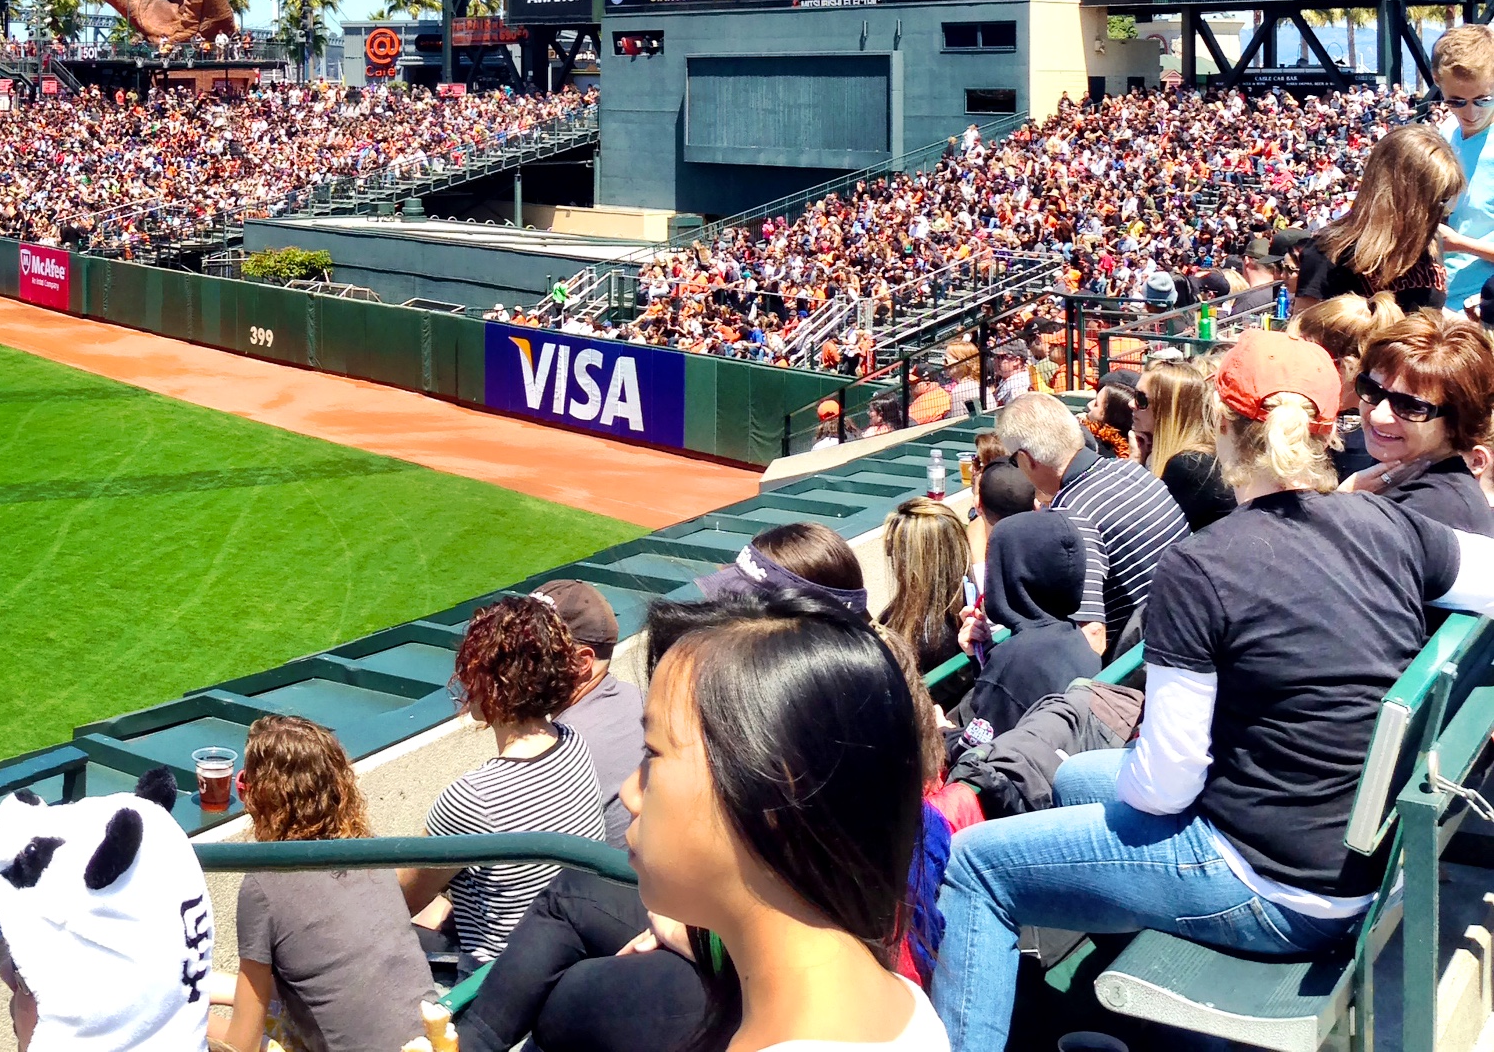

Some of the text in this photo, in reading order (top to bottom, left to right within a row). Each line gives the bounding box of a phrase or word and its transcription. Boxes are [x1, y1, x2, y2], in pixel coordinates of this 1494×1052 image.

[83, 48, 98, 59] 501
[31, 255, 65, 280] McAfee
[249, 326, 274, 348] 399
[508, 336, 644, 432] VISA
